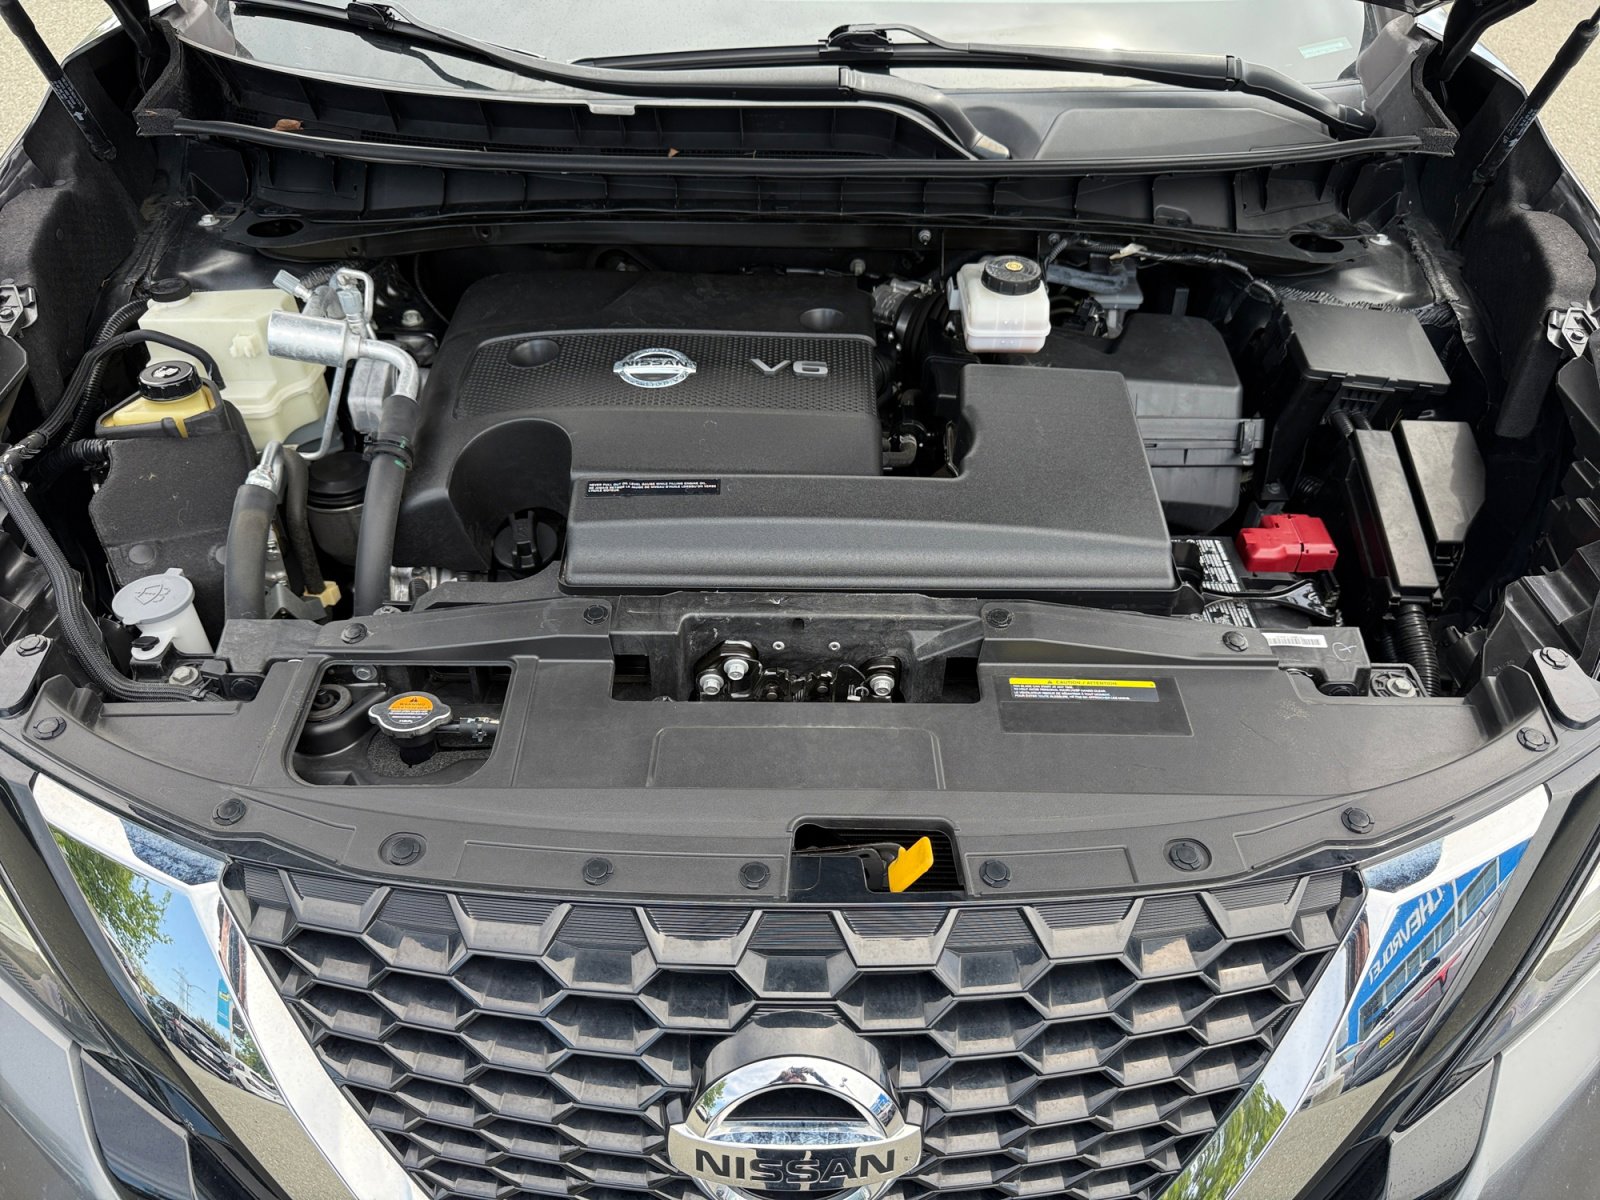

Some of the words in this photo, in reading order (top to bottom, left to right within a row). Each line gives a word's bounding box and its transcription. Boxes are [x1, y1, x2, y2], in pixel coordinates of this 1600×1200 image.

[622, 359, 688, 368] NISSAN
[750, 358, 829, 378] V6
[695, 1148, 896, 1184] NISSAN
